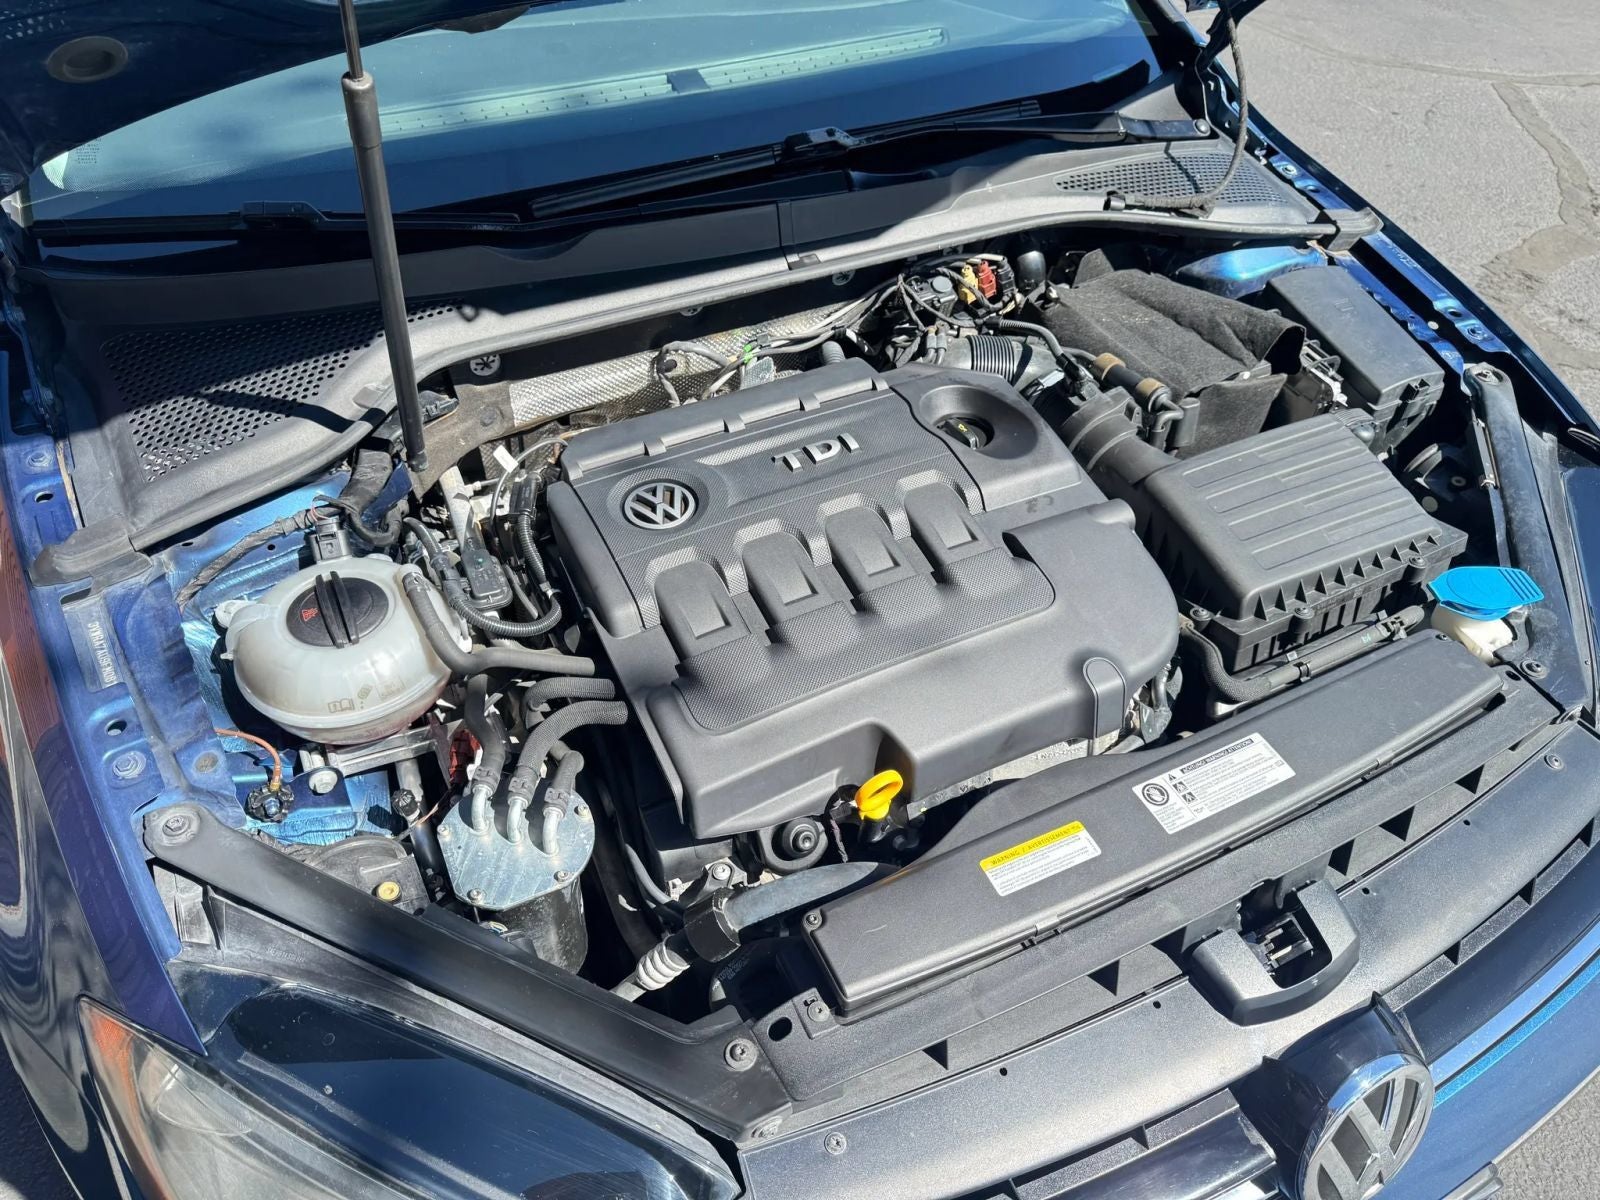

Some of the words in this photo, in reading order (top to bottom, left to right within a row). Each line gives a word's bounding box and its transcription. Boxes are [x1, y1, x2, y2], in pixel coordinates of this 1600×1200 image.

[771, 432, 861, 472] TDI
[624, 481, 697, 530] VW
[991, 849, 1020, 866] WARNING
